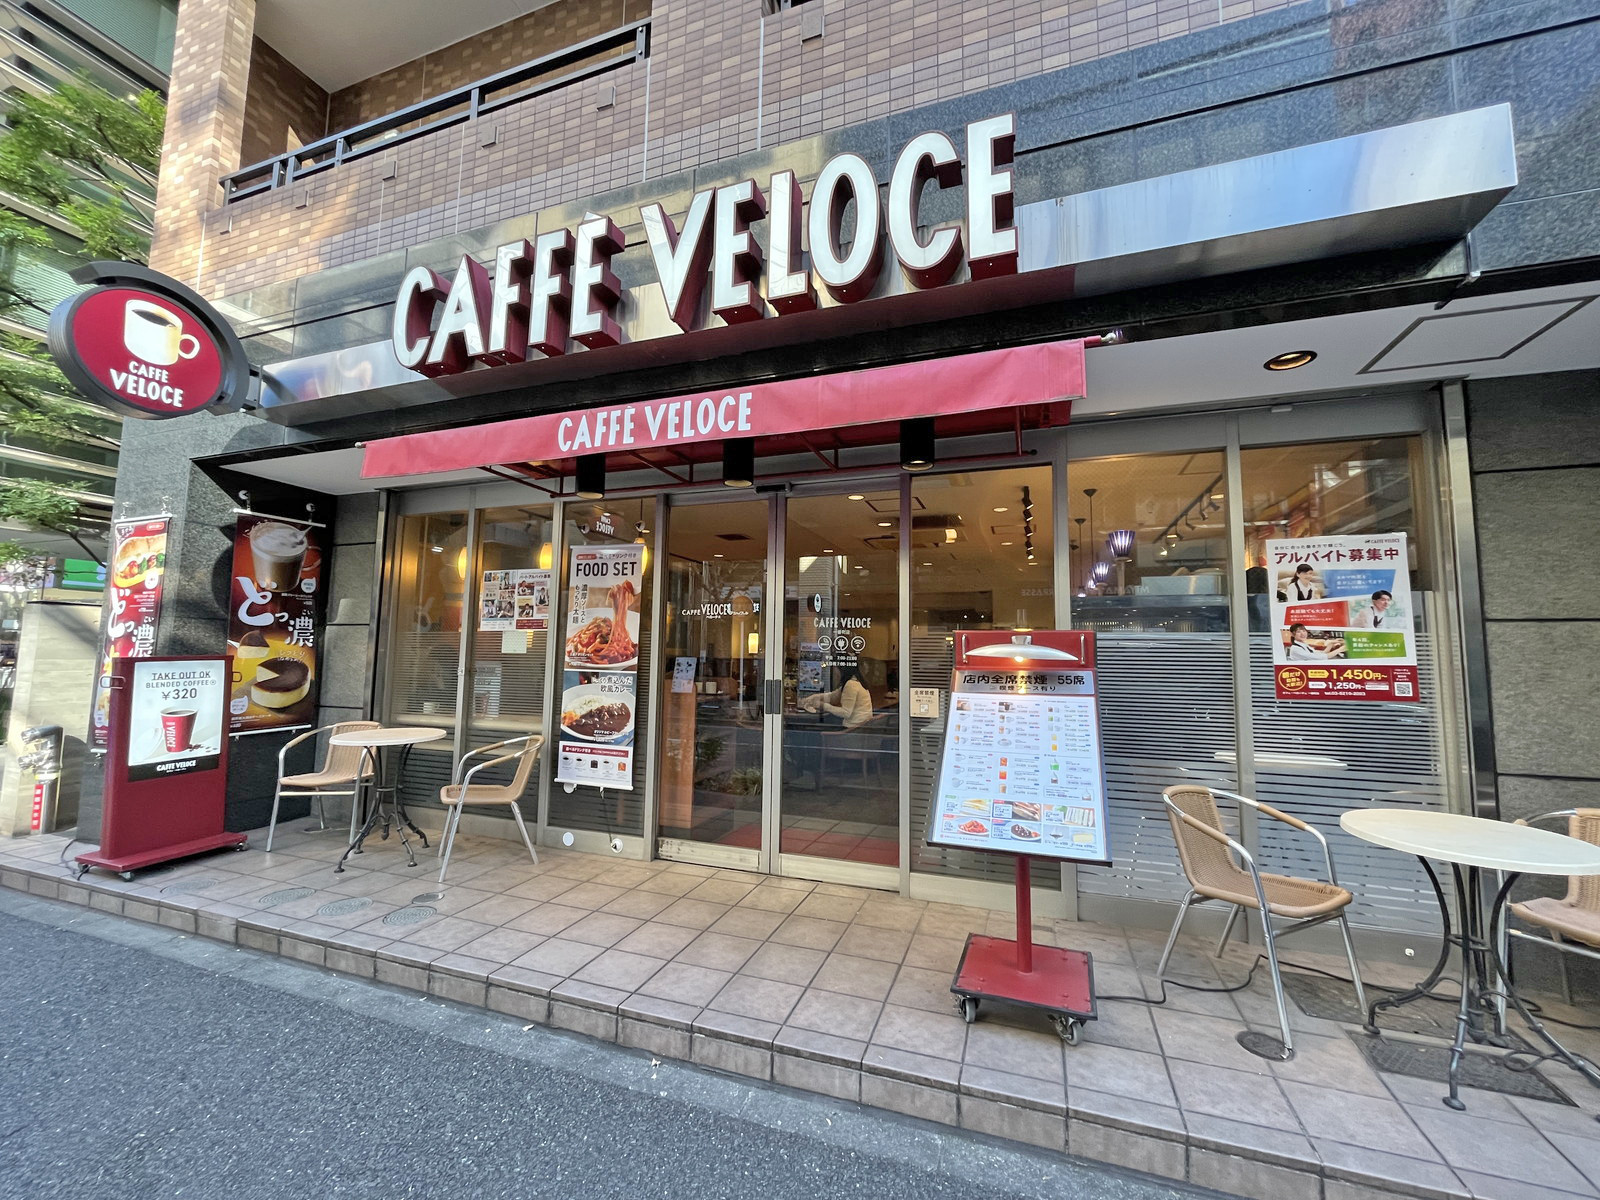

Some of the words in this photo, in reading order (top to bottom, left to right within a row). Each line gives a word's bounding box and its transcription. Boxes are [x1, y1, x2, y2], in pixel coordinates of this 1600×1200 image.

[640, 111, 1018, 333] VELOCE
[110, 368, 184, 408] VELOCE
[645, 392, 753, 440] VELOCE
[1274, 547, 1400, 564] アルバイト募集中
[576, 562, 609, 577] FOOD
[612, 561, 638, 576] SET
[840, 617, 872, 629] VELOCE
[152, 672, 176, 680] TAKE
[179, 671, 197, 680] OUT
[199, 671, 211, 679] OK
[963, 674, 1048, 685] 店内全席禁煙
[1057, 675, 1085, 685] 55席
[162, 688, 198, 700] ¥320
[176, 760, 197, 768] VELOCE
